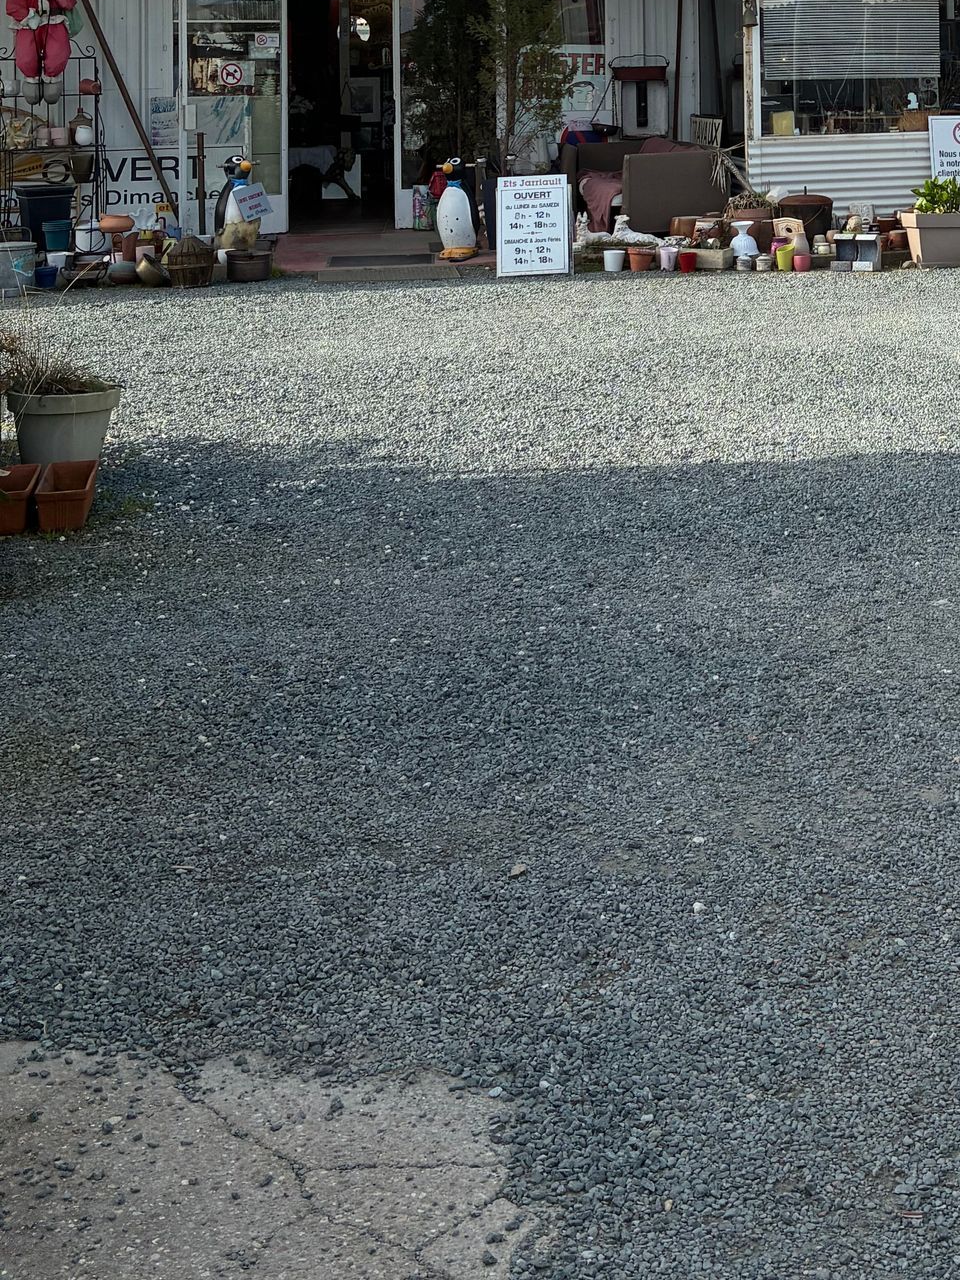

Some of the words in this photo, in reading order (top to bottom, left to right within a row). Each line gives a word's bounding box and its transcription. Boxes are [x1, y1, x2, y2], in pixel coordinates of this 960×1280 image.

[938, 150, 957, 158] Nous
[503, 180, 517, 188] Ets
[513, 191, 552, 199] OUVERT
